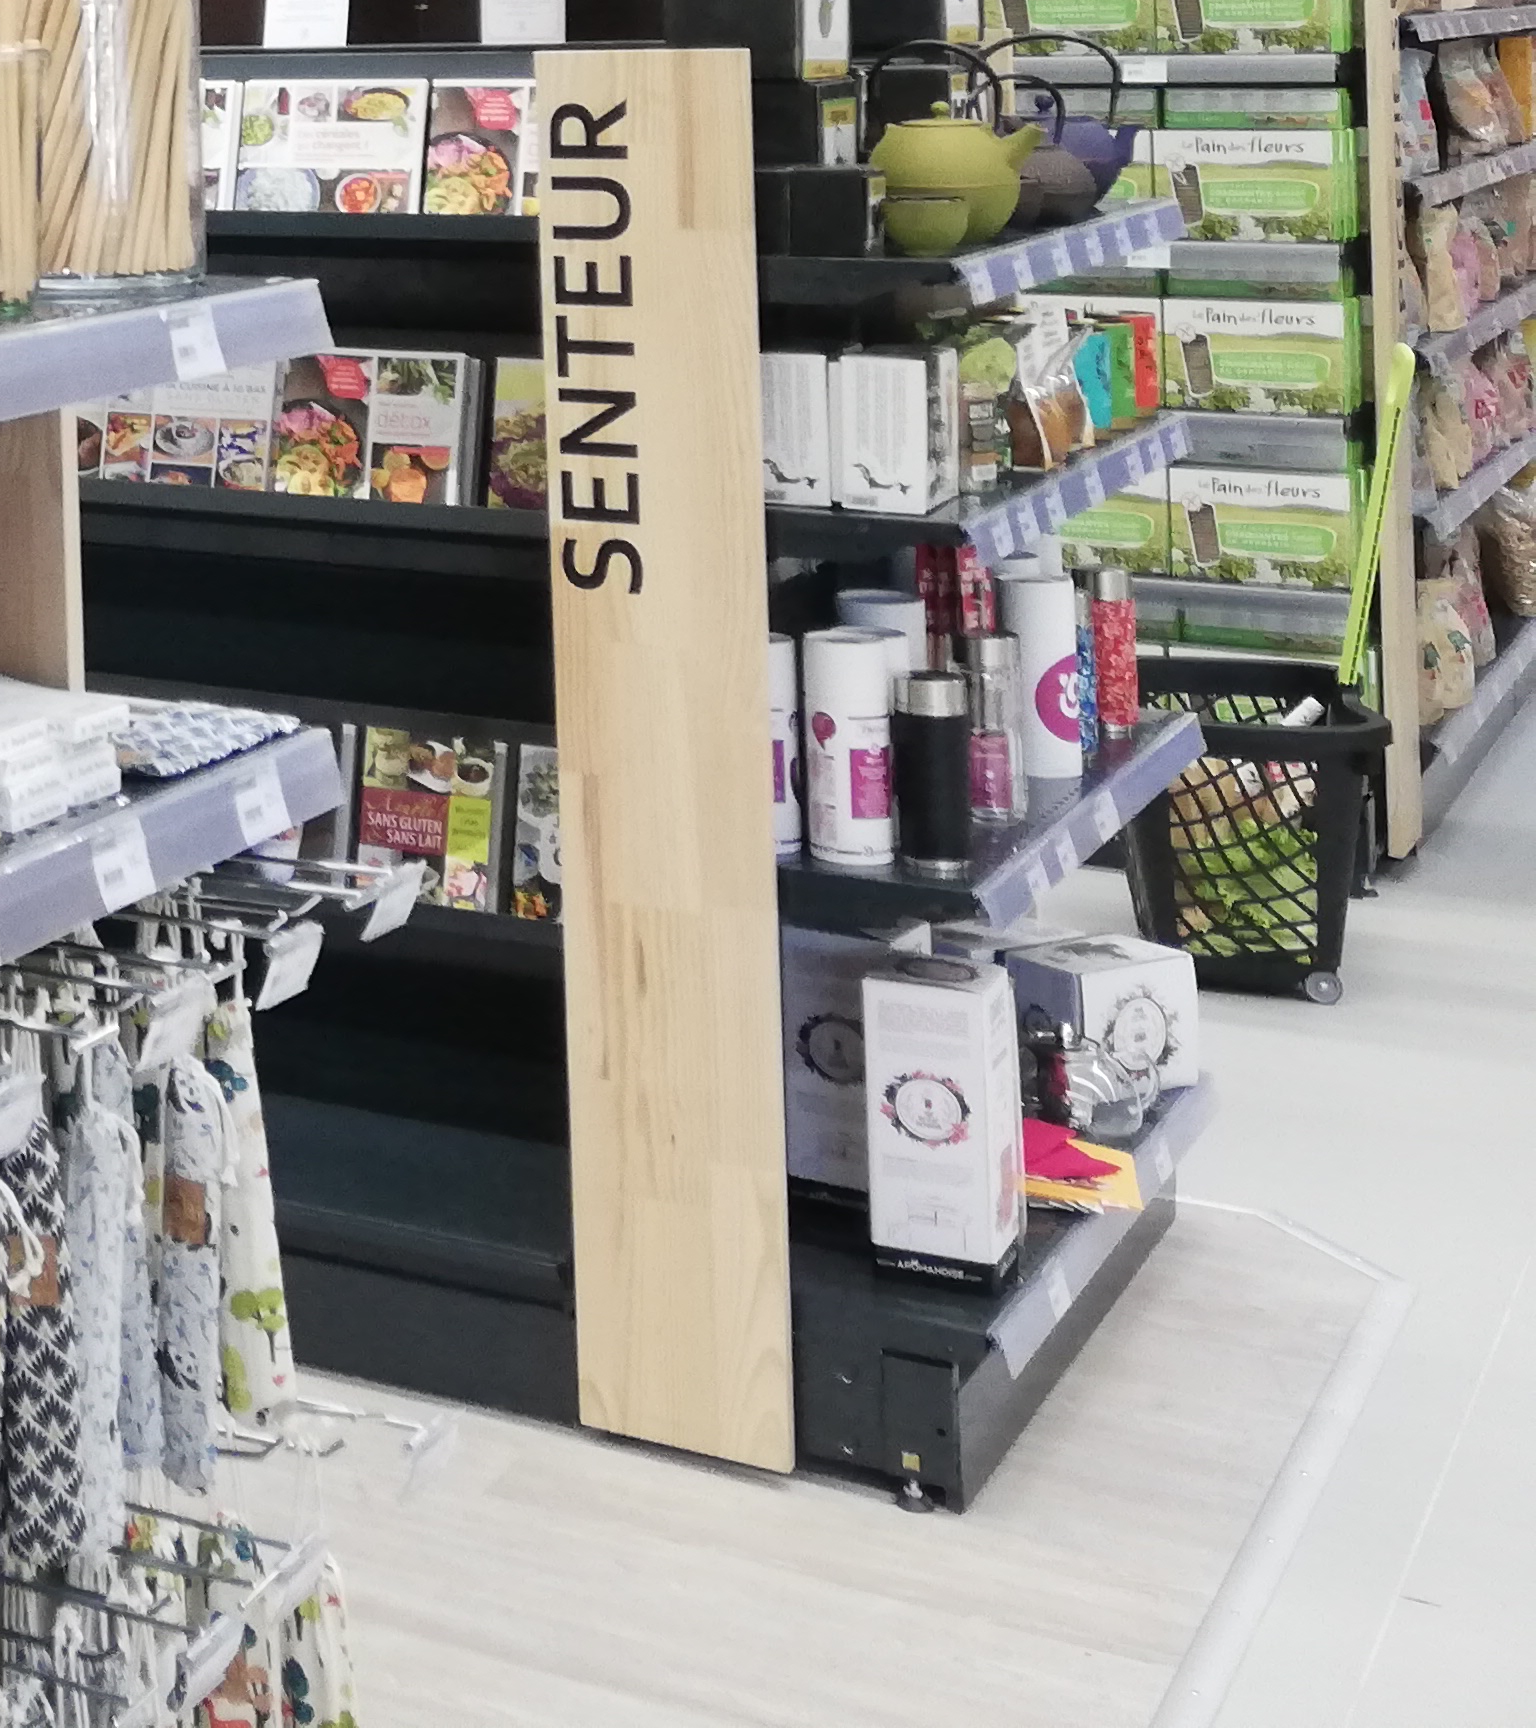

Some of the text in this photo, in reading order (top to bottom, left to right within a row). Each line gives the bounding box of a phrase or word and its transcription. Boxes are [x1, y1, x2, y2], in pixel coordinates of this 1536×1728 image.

[1195, 137, 1227, 153] Pain
[1248, 136, 1305, 153] fleurs
[1206, 307, 1238, 325] Pain
[1261, 308, 1316, 326] fleurs
[549, 98, 644, 596] SENTEUR
[1211, 477, 1243, 496] Pain
[1265, 480, 1320, 498] fleurs
[368, 812, 442, 834] SANS GLUTEN
[387, 830, 442, 849] SANS LAIT
